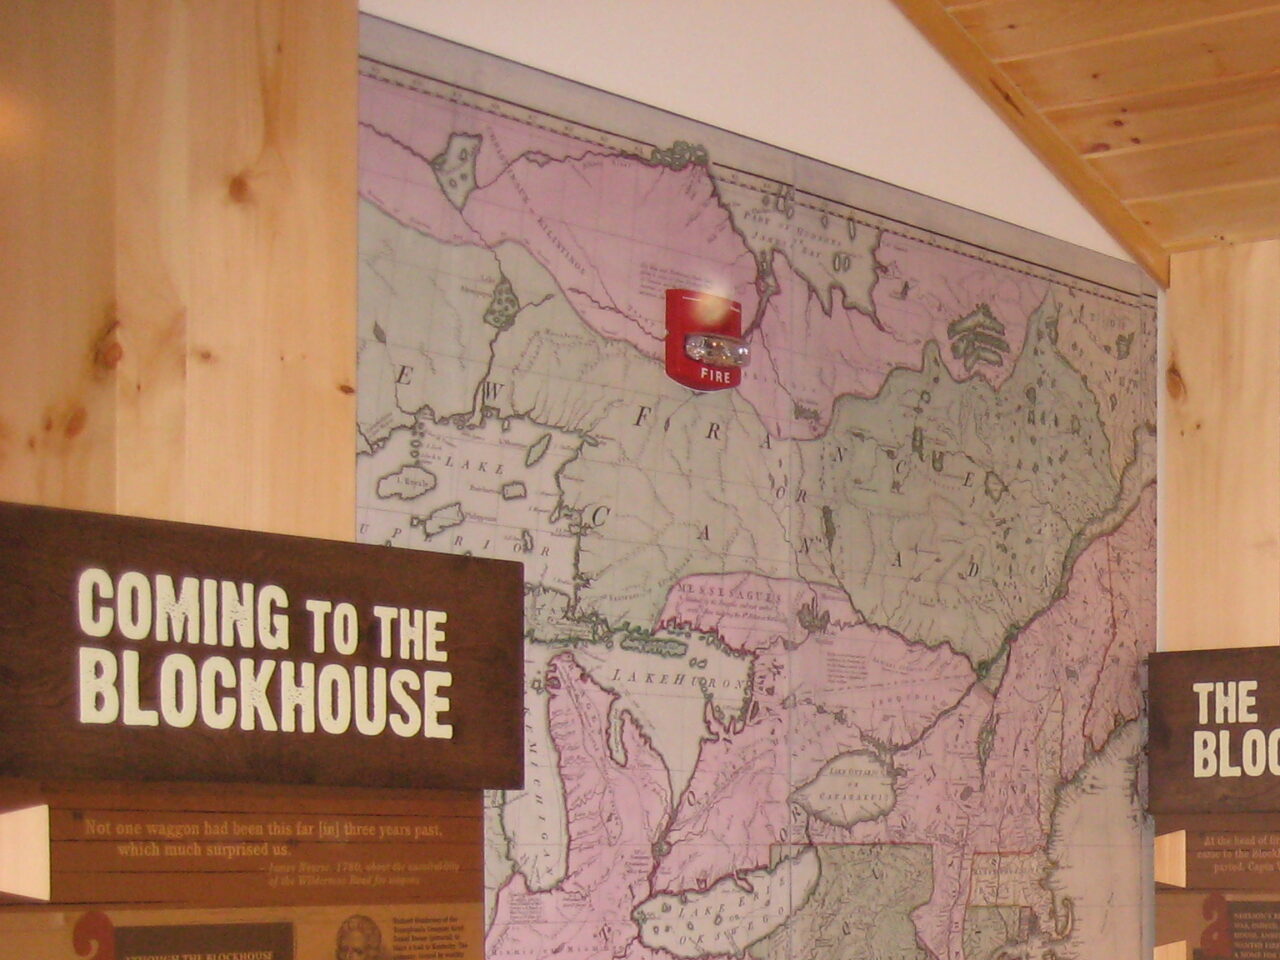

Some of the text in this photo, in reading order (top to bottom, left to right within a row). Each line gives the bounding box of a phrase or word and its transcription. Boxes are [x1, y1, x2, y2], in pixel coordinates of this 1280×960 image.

[700, 366, 731, 384] FIRE
[79, 568, 449, 663] COMING TO THE
[79, 645, 454, 740] BLOCKHOUSE
[1193, 680, 1259, 725] THE
[116, 824, 142, 836] one
[147, 823, 200, 839] waggon
[204, 821, 229, 836] had
[233, 821, 264, 836] been
[267, 821, 293, 836] this
[296, 821, 314, 836] far
[344, 821, 376, 836] three
[378, 824, 411, 840] years
[118, 842, 160, 856] which
[164, 842, 201, 856] much
[206, 842, 268, 860] surprised
[1235, 848, 1250, 859] the
